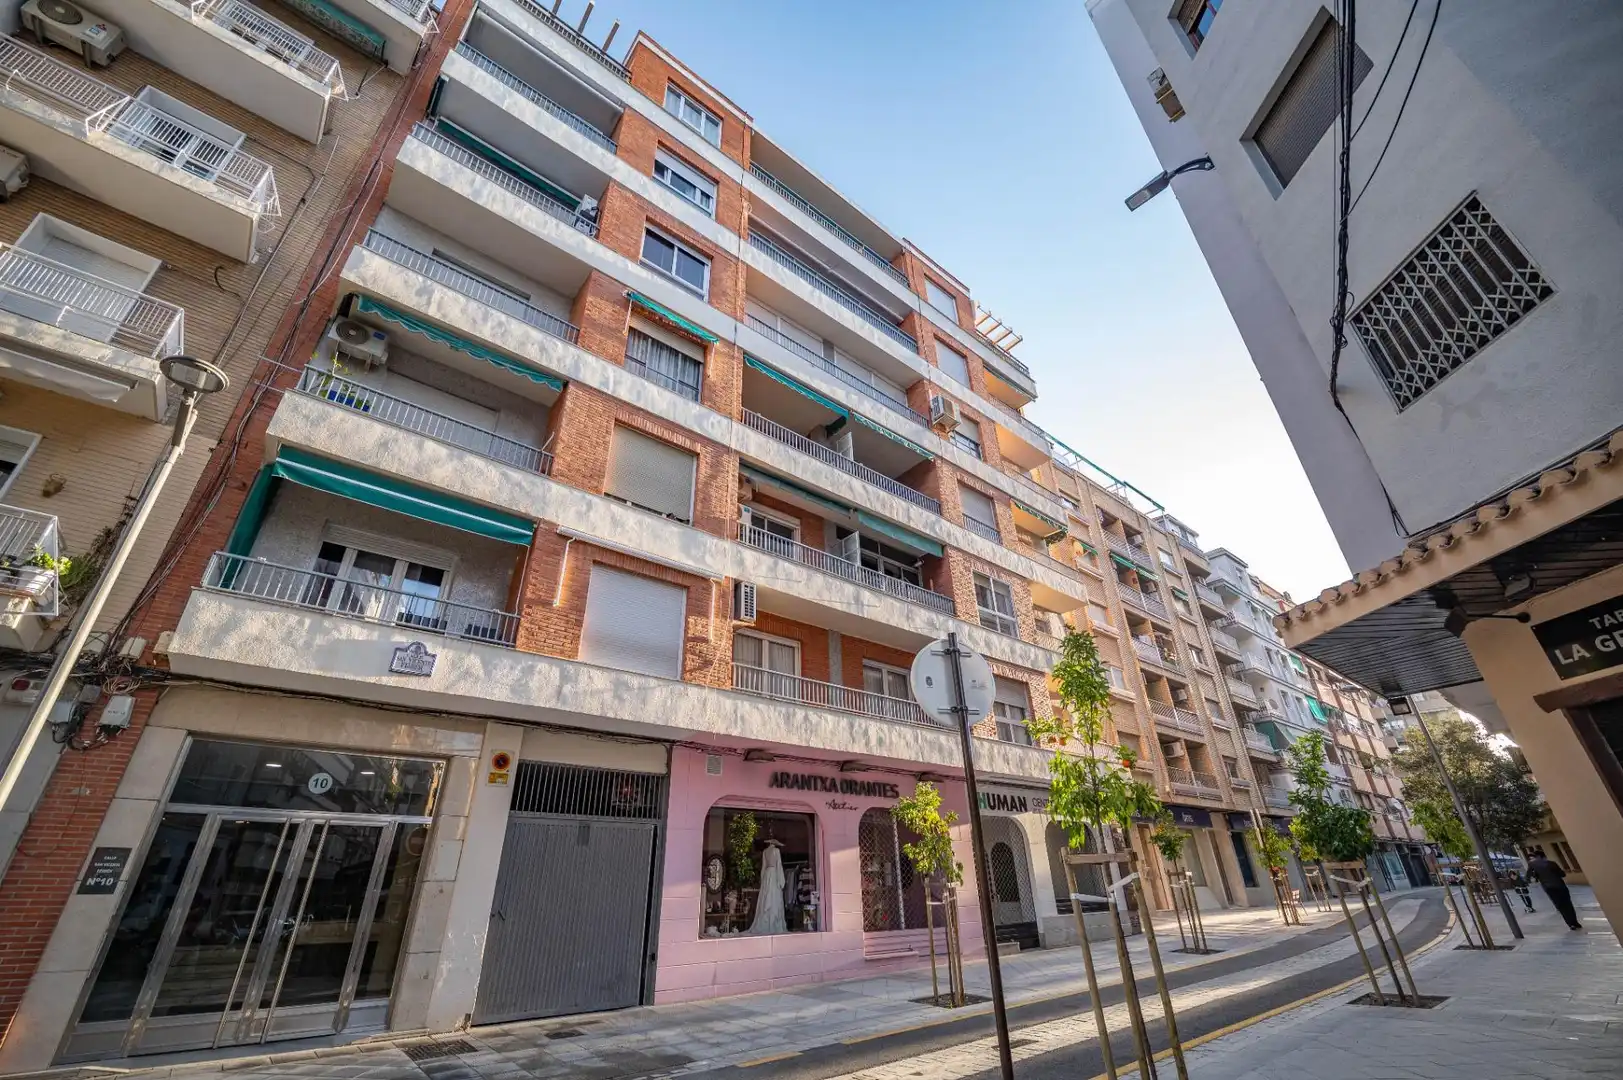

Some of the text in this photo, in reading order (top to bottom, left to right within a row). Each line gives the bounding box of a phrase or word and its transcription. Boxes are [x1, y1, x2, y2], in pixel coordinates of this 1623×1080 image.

[1554, 643, 1591, 665] LA
[313, 778, 328, 788] 10
[768, 771, 900, 799] ARANTXA ORANTES
